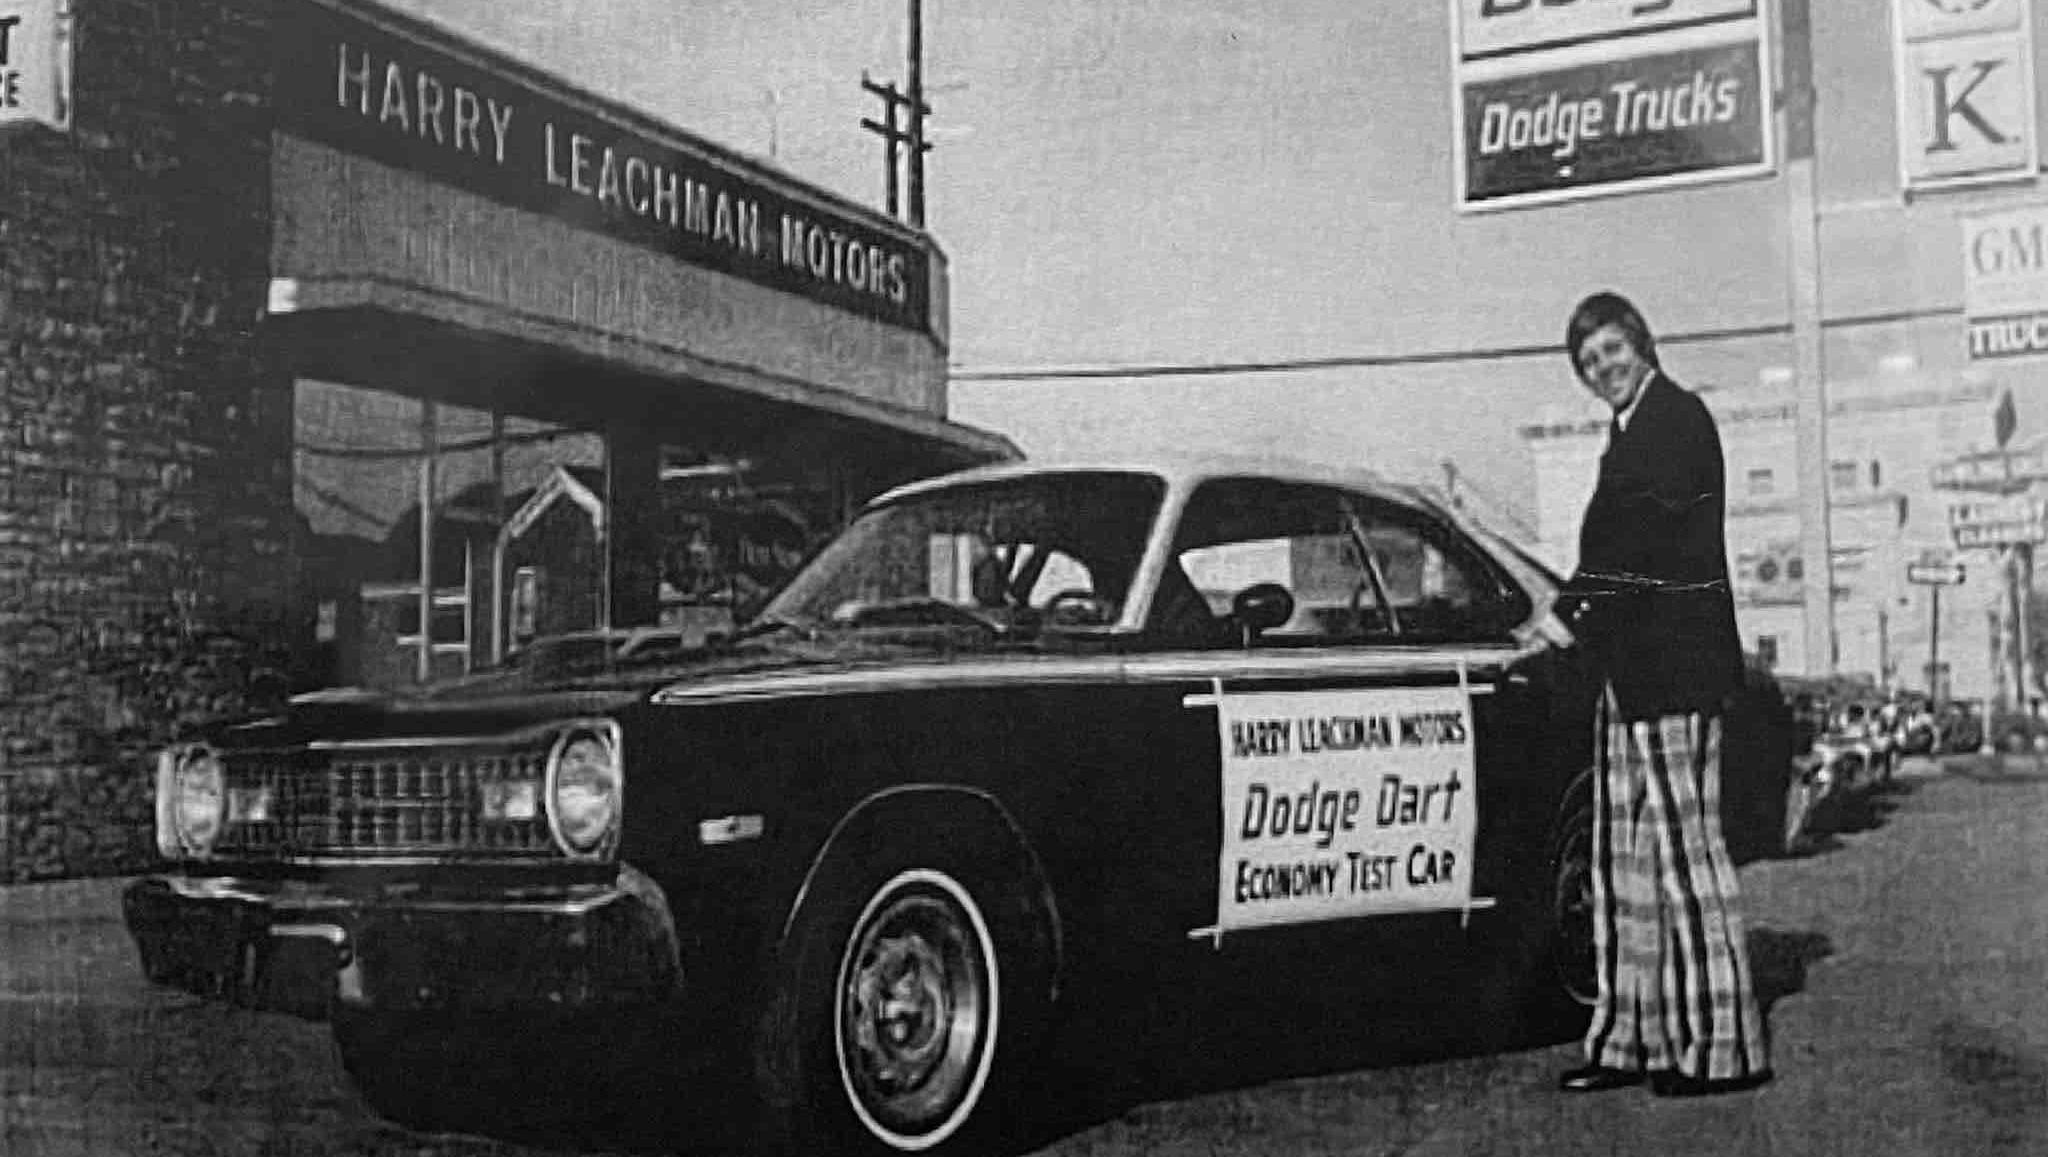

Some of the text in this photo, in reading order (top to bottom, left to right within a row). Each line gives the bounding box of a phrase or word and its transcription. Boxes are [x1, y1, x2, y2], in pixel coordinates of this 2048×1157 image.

[1480, 69, 1740, 157] Dodge Trucks
[1923, 59, 2008, 155] K
[338, 42, 905, 301] HARRY LEACHMAN MOTORS
[1242, 768, 1462, 849] Dodge Dart
[1235, 843, 1456, 903] ECONOMY TEST CAR
